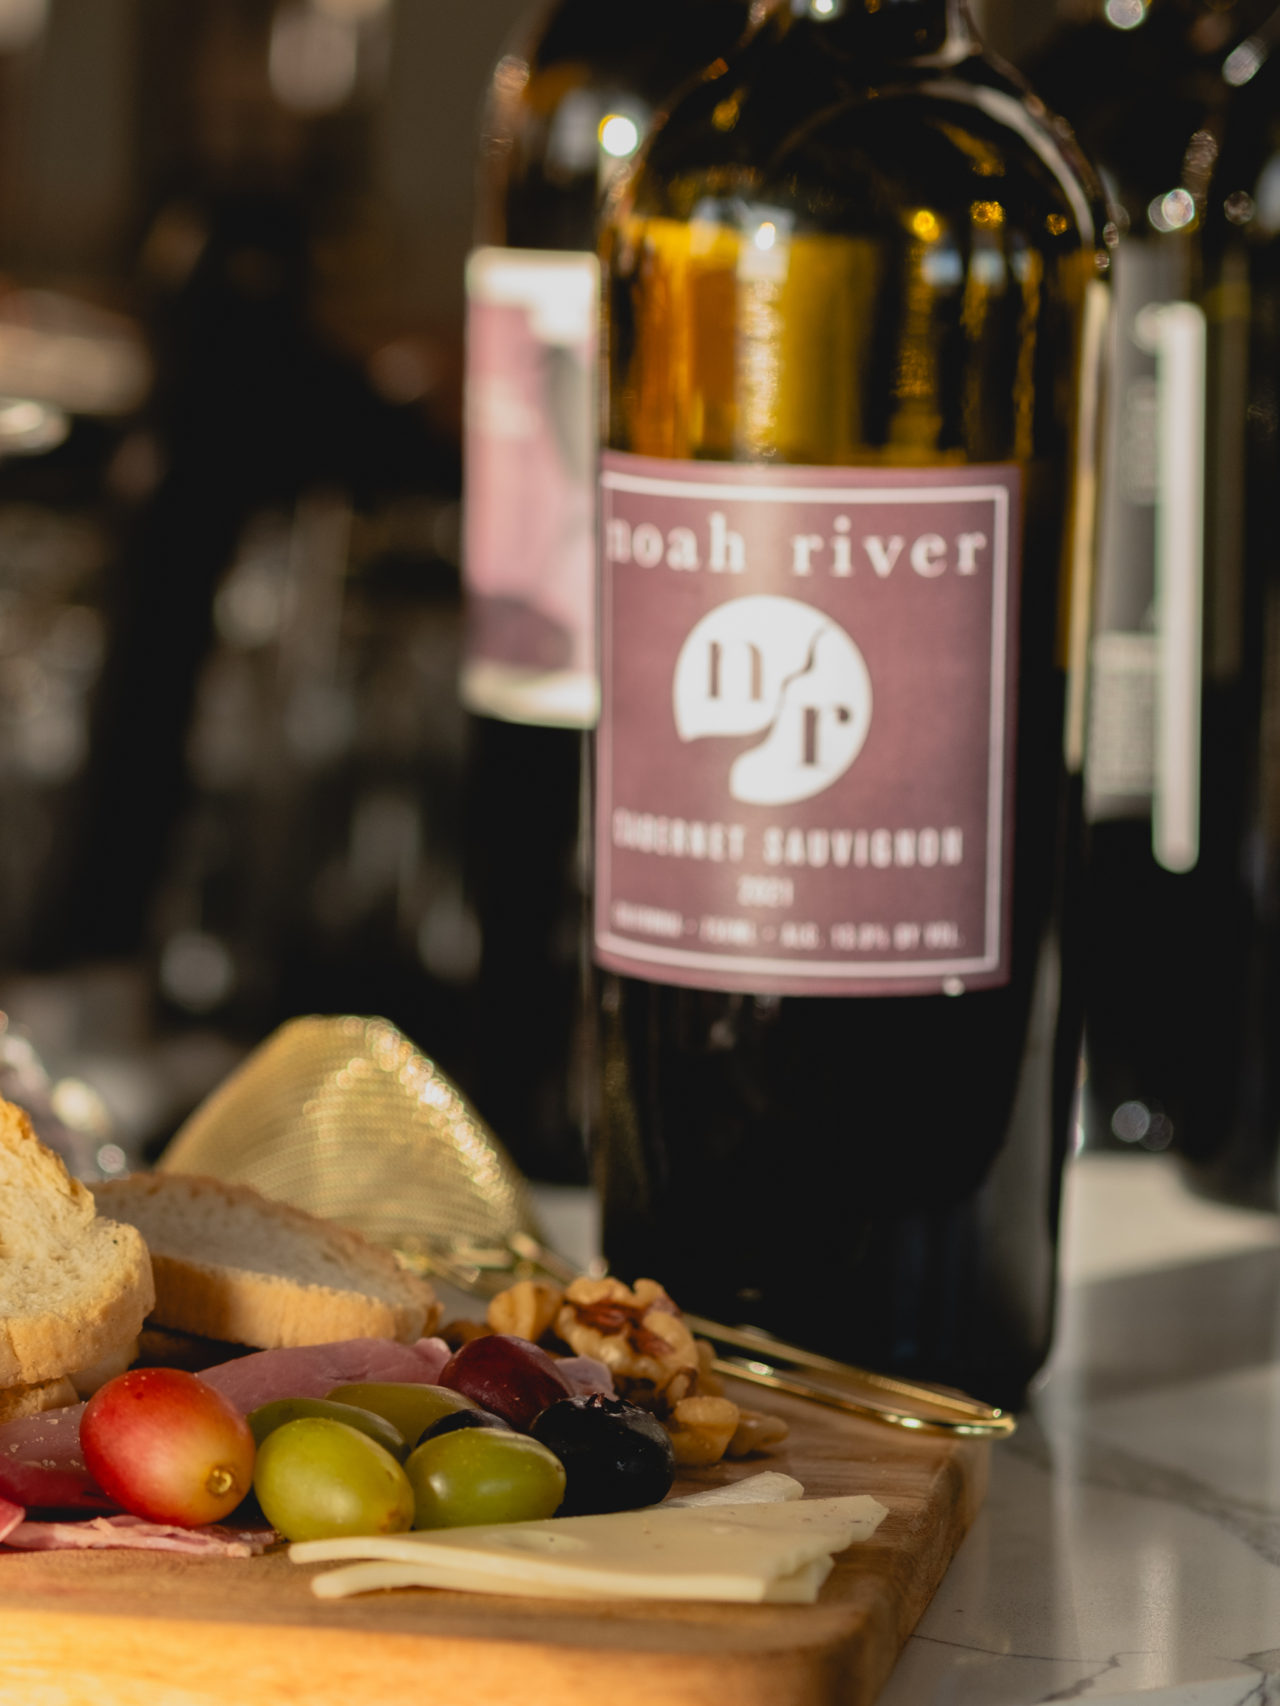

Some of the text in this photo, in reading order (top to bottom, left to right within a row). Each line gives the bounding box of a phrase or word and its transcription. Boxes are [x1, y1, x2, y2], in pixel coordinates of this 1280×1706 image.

[606, 511, 987, 578] noah river
[763, 826, 963, 868] SAUVIGNON
